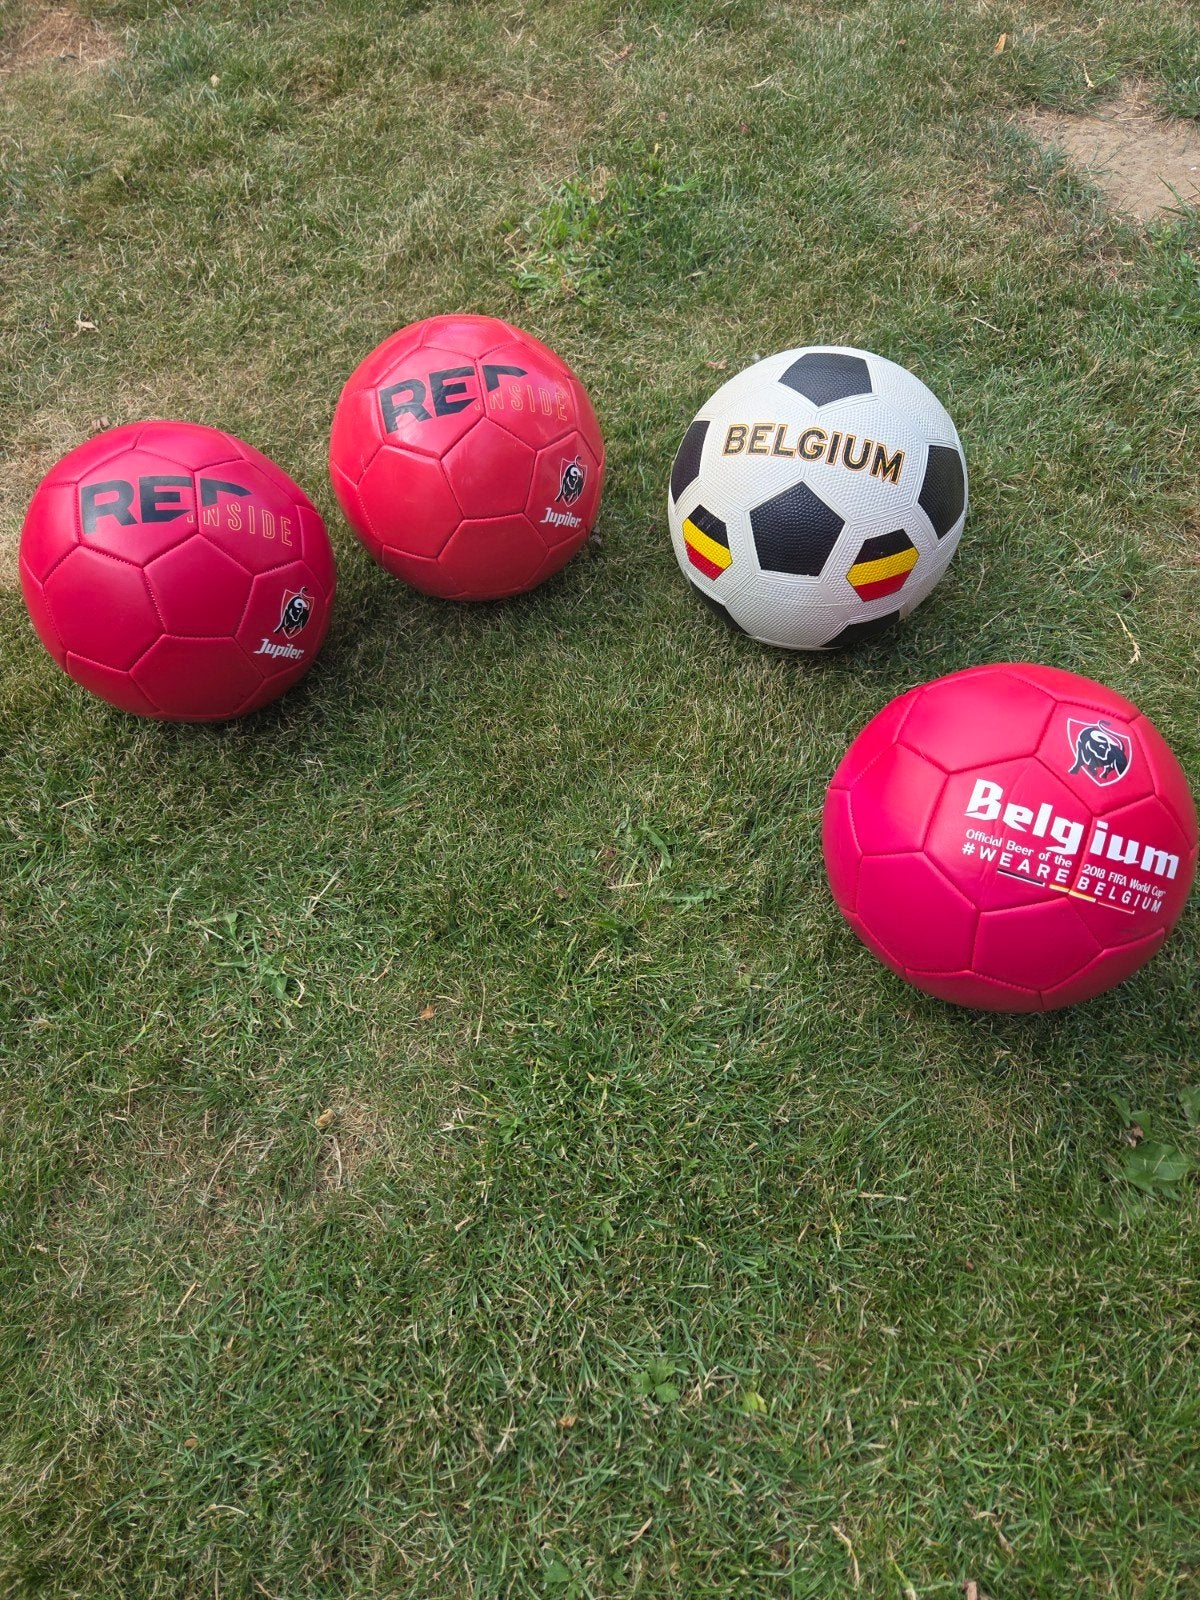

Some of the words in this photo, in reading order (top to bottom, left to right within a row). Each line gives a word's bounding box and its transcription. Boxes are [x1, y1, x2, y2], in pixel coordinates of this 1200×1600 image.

[722, 422, 905, 485] BELGIUM
[540, 507, 582, 528] Jupiler
[253, 638, 305, 660] Jupiler
[964, 778, 1179, 879] Belgium
[965, 829, 1003, 847] Official
[1006, 840, 1034, 856] Beer
[1038, 851, 1052, 862] of
[1054, 855, 1073, 868] the
[1082, 863, 1106, 879] 2018
[1108, 872, 1127, 886] FIFA
[1129, 878, 1151, 894] World
